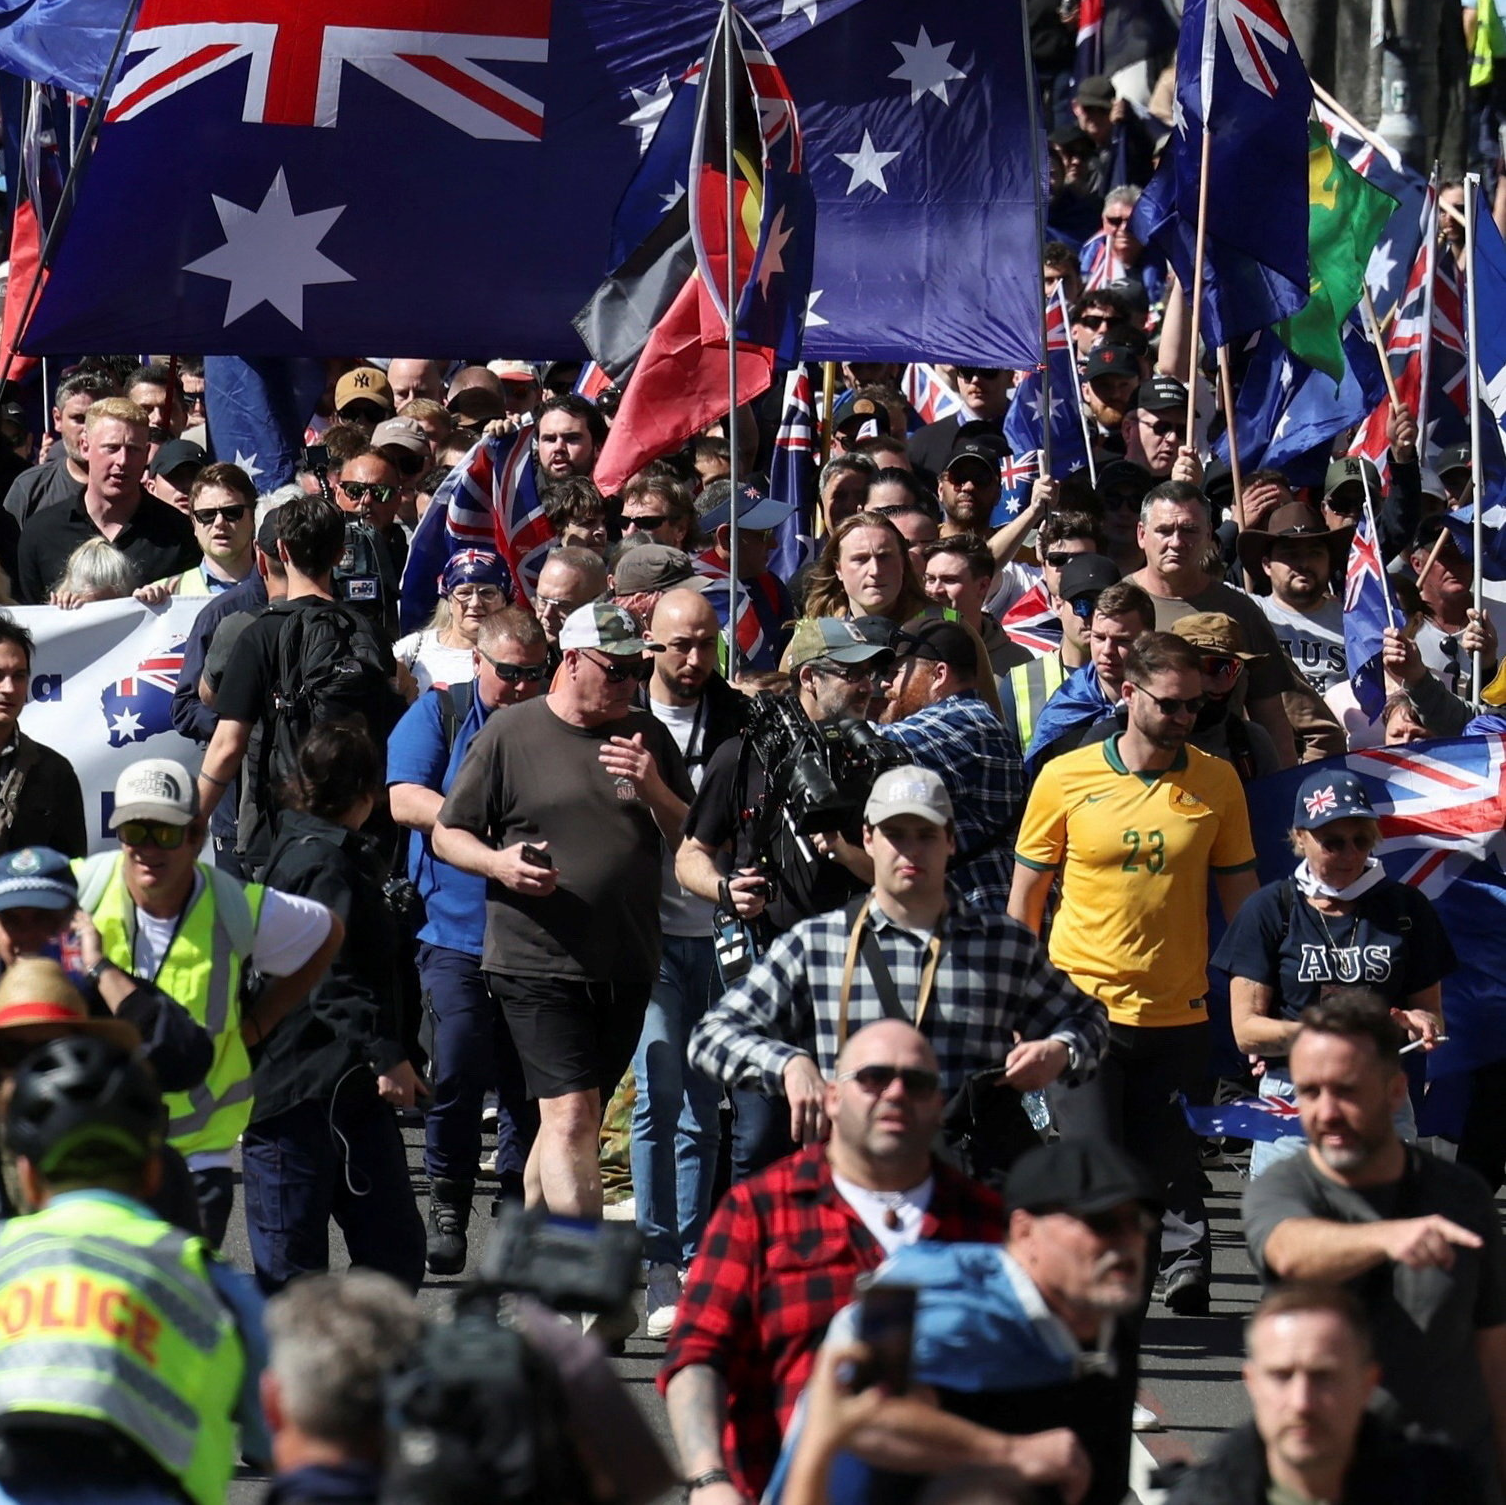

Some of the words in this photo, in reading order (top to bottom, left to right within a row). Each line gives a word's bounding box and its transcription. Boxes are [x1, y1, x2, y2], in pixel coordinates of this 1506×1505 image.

[354, 371, 370, 389] NY
[1122, 830, 1165, 874] 23
[1297, 943, 1392, 983] AUS
